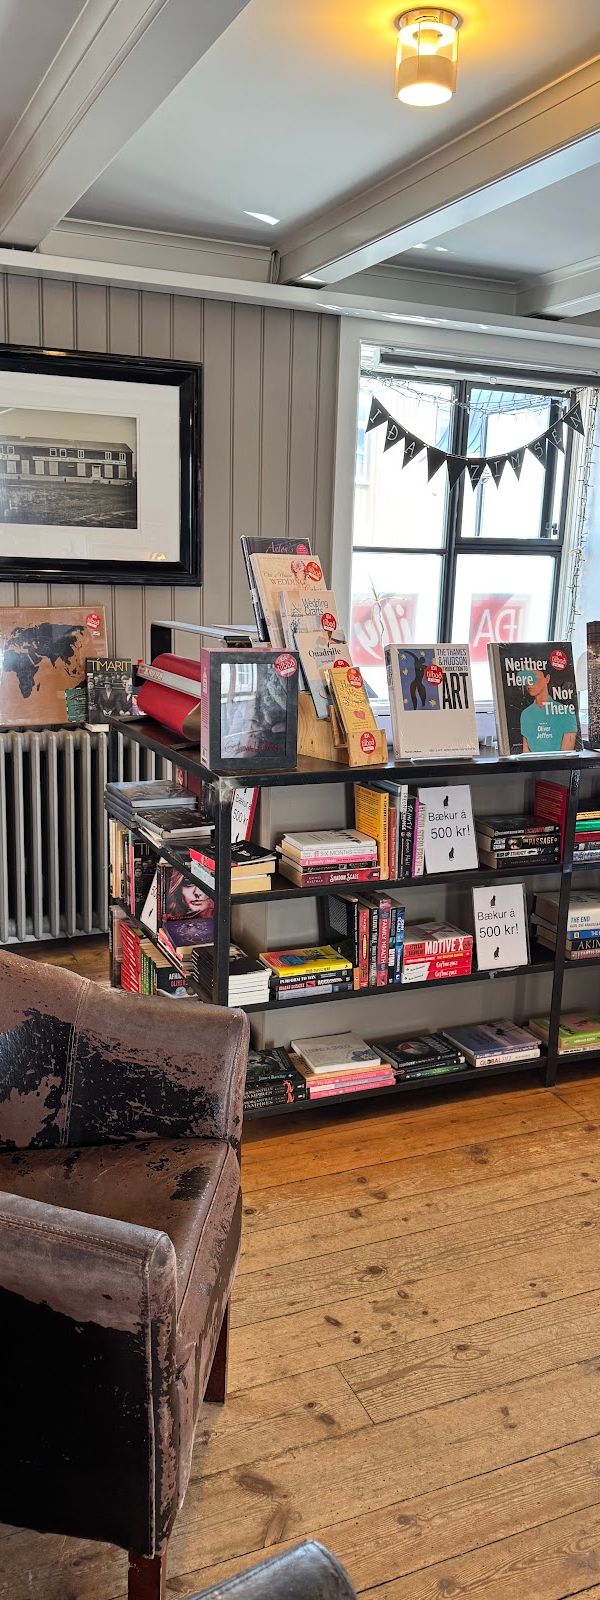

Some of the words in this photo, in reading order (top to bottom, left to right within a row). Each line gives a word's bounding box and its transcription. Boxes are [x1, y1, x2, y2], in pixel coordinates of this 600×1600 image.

[470, 410, 582, 480] ZIMSEN
[308, 648, 342, 658] Quadrille
[90, 656, 130, 672] TÍMARIT
[444, 656, 468, 666] HUDSON
[504, 658, 548, 672] Neither
[506, 673, 533, 687] Here
[442, 672, 470, 710] ART
[552, 687, 574, 700] Nor
[543, 702, 576, 715] There
[232, 809, 243, 822] 500
[428, 812, 458, 822] Bækur
[460, 810, 466, 819] á
[431, 826, 452, 840] 500
[456, 825, 470, 836] kr!
[528, 836, 554, 846] PASSAGE
[478, 911, 507, 921] Bækur
[510, 909, 516, 918] á
[479, 926, 500, 938] 500
[504, 922, 518, 936] kr!
[425, 938, 456, 955] MOTIVE
[458, 938, 464, 951] X
